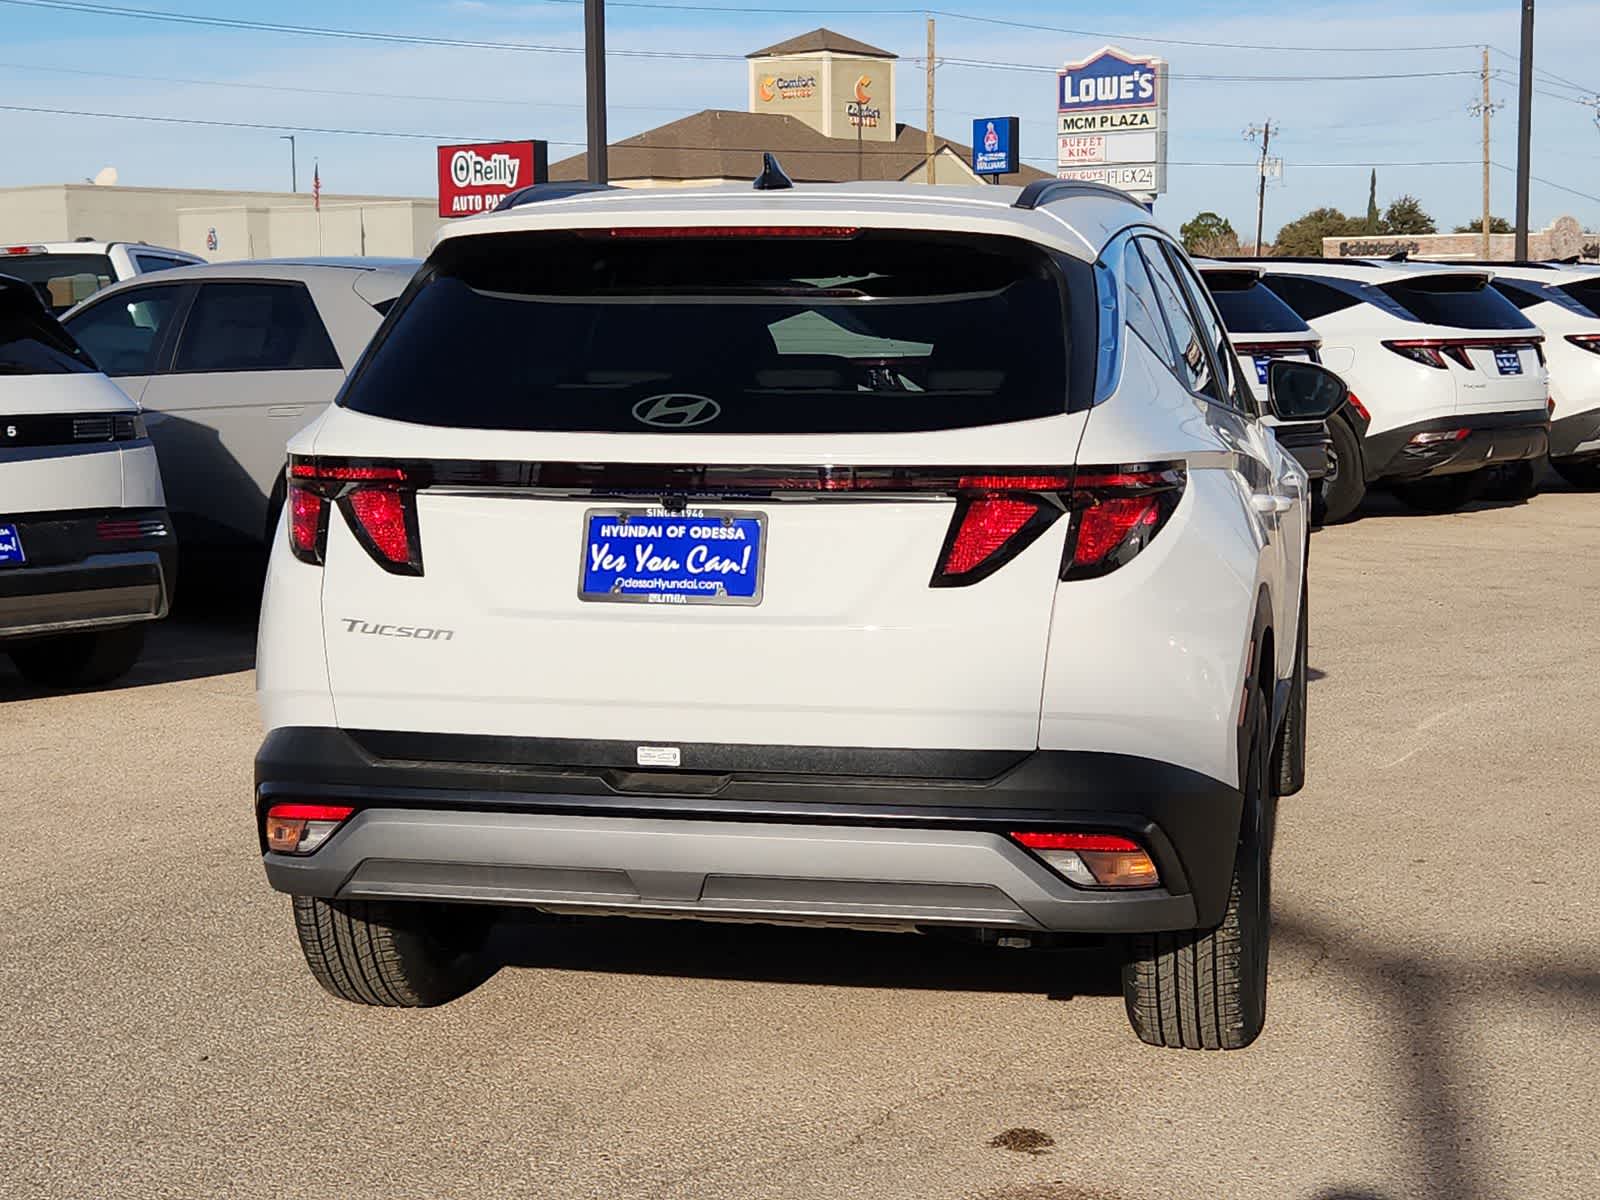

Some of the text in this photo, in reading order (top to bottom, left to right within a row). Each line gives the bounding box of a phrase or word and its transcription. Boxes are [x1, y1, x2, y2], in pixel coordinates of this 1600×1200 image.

[777, 76, 816, 89] Comfort
[1064, 71, 1153, 103] LOWE'S
[1063, 113, 1149, 130] MCM PLAZA
[1062, 137, 1102, 148] BUFFET
[1068, 148, 1096, 157] KING
[454, 155, 516, 184] O'Reilly
[1080, 170, 1104, 179] GUYS
[453, 195, 482, 211] AUTO
[6, 425, 17, 437] 5
[681, 509, 704, 518] 1946
[601, 524, 745, 540] HYUNDAI OF ODESSA
[591, 543, 751, 574] Yes You Can!
[615, 577, 724, 590] OdessaHyundai.com
